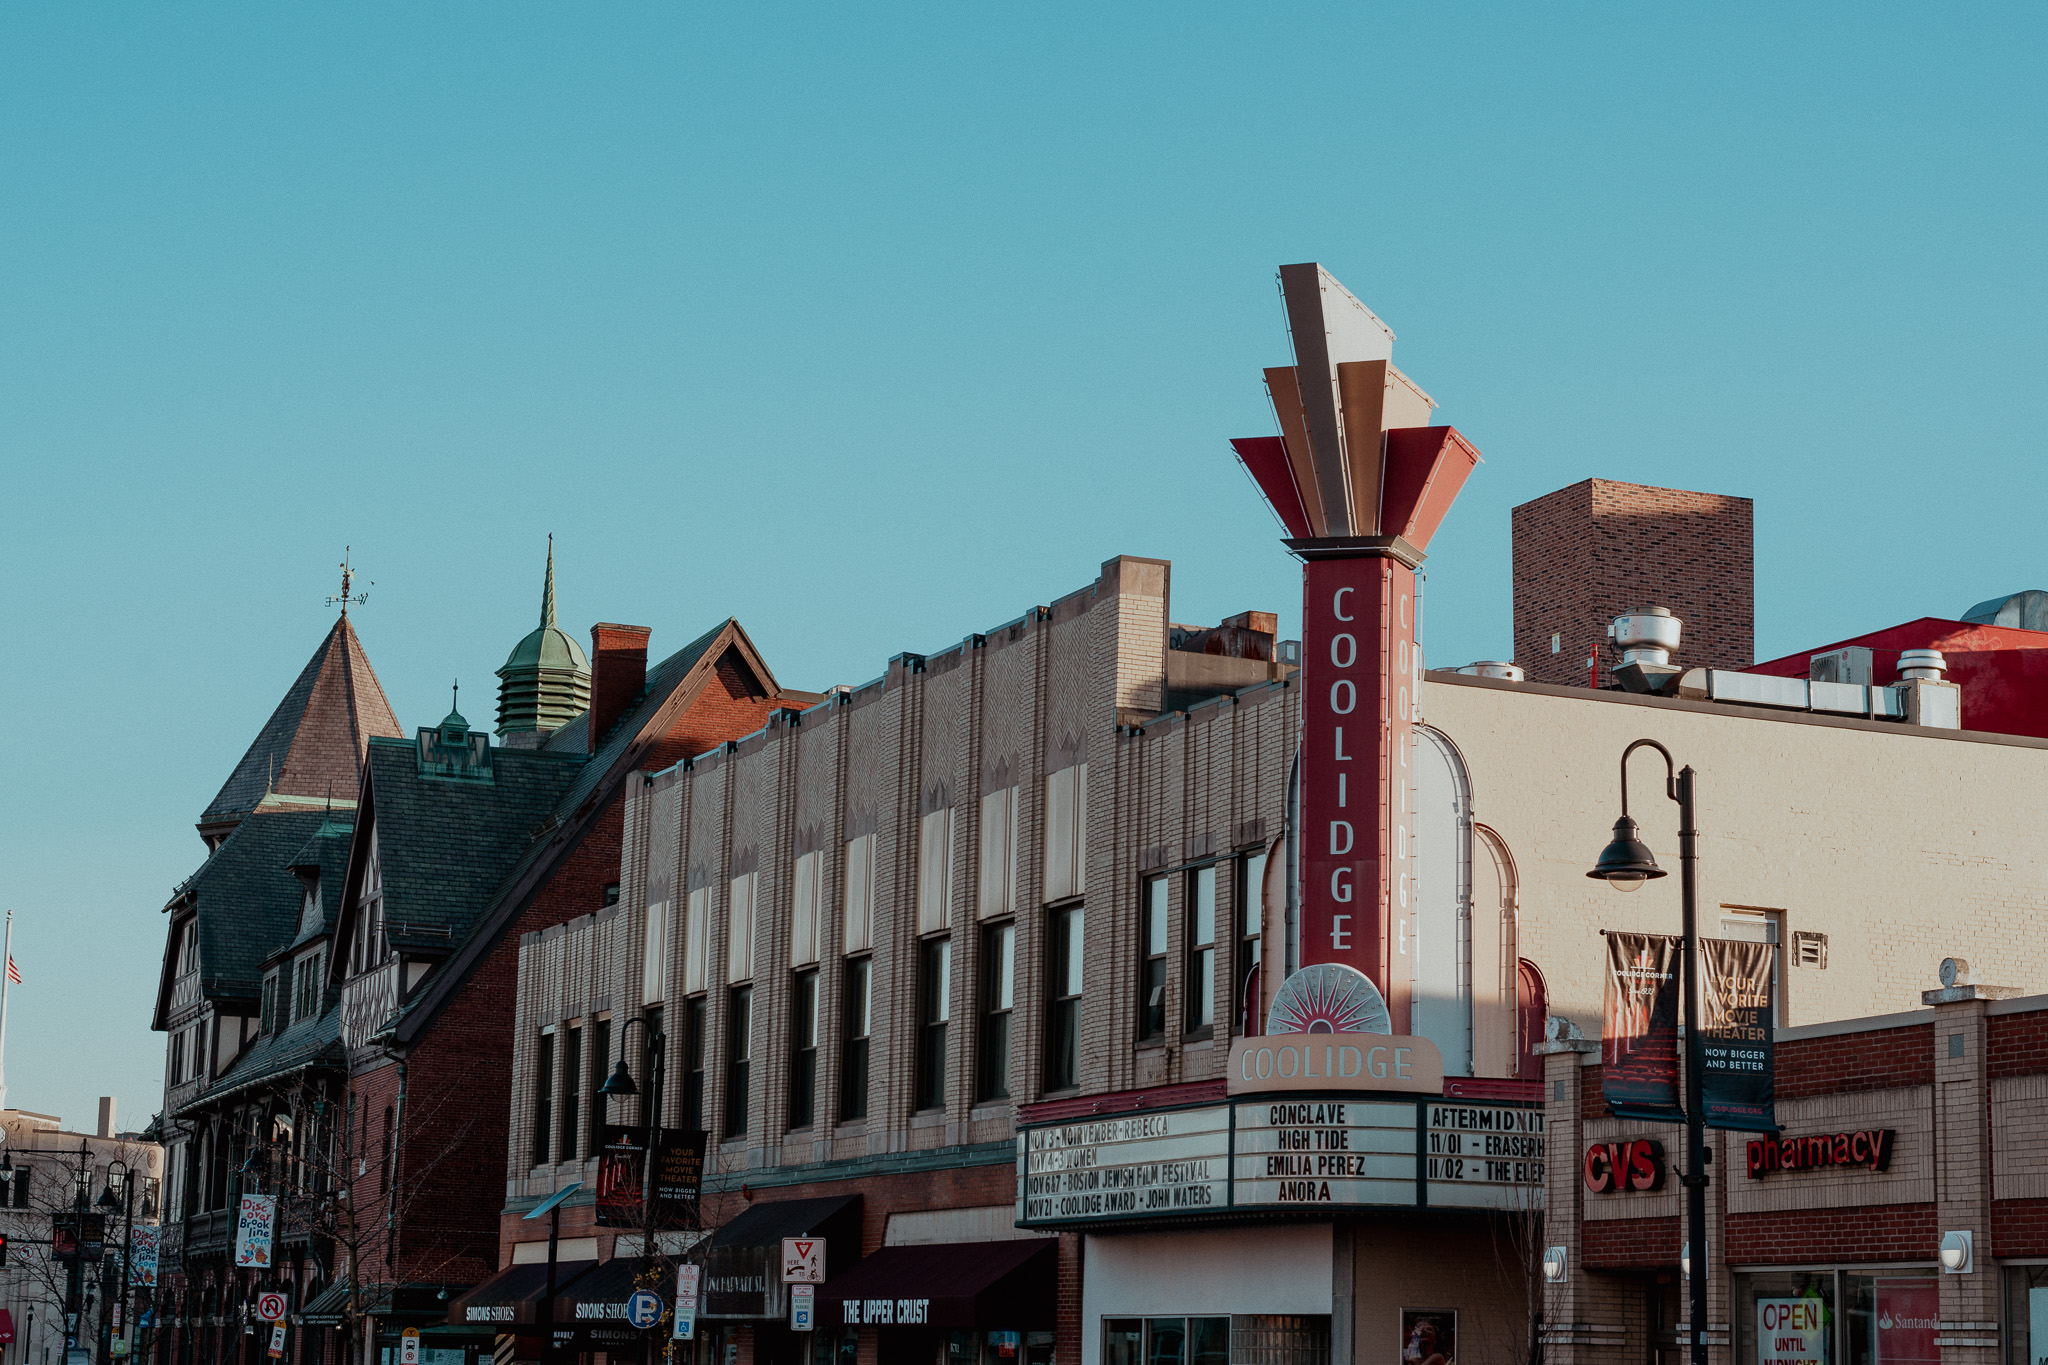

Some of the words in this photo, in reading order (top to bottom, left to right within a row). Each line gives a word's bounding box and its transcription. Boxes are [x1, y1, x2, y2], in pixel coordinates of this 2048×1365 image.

[1330, 587, 1356, 949] COOLIDGE
[1399, 594, 1408, 955] COOLIDGE
[1717, 975, 1755, 992] YOUR
[1705, 991, 1768, 1008] FAVORITE
[1713, 1009, 1758, 1024] MOVIE
[1705, 1025, 1766, 1041] THEATER
[1705, 1048, 1728, 1057] NOW
[1730, 1049, 1765, 1060] BIGGER
[1242, 1045, 1413, 1081] COOLIDGE
[1706, 1060, 1726, 1069] AND
[1729, 1061, 1764, 1071] BETTER
[1270, 1104, 1345, 1126] CONCLAVE
[1711, 1105, 1763, 1115] COOLIDGE.ORG
[1030, 1131, 1045, 1150] NOV
[1048, 1130, 1054, 1148] 3
[1124, 1116, 1168, 1139] REBECCA
[1278, 1129, 1311, 1151] HIGH
[1315, 1129, 1349, 1150] TIDE
[1430, 1132, 1461, 1154] 11/01
[670, 1148, 694, 1156] YOUR
[1747, 1129, 1887, 1179] pharmacy
[660, 1156, 701, 1166] FAVORITE
[1030, 1152, 1045, 1173] NOV
[1066, 1148, 1097, 1168] WOMEN
[1266, 1156, 1312, 1177] EMILIA
[1318, 1155, 1365, 1176] PEREZ
[1585, 1139, 1659, 1193] CVS
[665, 1166, 694, 1175] MOVIE
[1068, 1170, 1100, 1192] BOSTON
[1102, 1168, 1134, 1188] JEWISH
[1136, 1166, 1158, 1186] FILM
[1162, 1160, 1210, 1184] FESTIVAL
[1428, 1158, 1464, 1179] 11/02
[1486, 1160, 1510, 1180] THE
[660, 1174, 698, 1184] THEATER
[1278, 1181, 1331, 1202] ANORA
[242, 1199, 268, 1212] Disc
[1060, 1195, 1101, 1216] COOLIDGE
[1104, 1191, 1136, 1212] AWARD
[1146, 1188, 1170, 1209] JOHN
[1174, 1185, 1212, 1206] WATERS
[240, 1218, 270, 1228] Brook
[246, 1211, 272, 1221] over
[133, 1229, 154, 1240] Disc
[248, 1227, 270, 1238] line
[130, 1246, 156, 1254] Brook
[136, 1240, 158, 1248] over
[139, 1253, 156, 1262] line
[466, 1306, 490, 1321] SIMONS
[490, 1306, 515, 1321] SHOES
[843, 1300, 860, 1324] THE
[863, 1299, 894, 1324] UPPER
[896, 1298, 930, 1324] CRUST
[1763, 1304, 1818, 1330] OPEN
[1895, 1312, 1939, 1329] Santand
[590, 1329, 638, 1340] SIMONS
[1774, 1338, 1806, 1352] UNTIL
